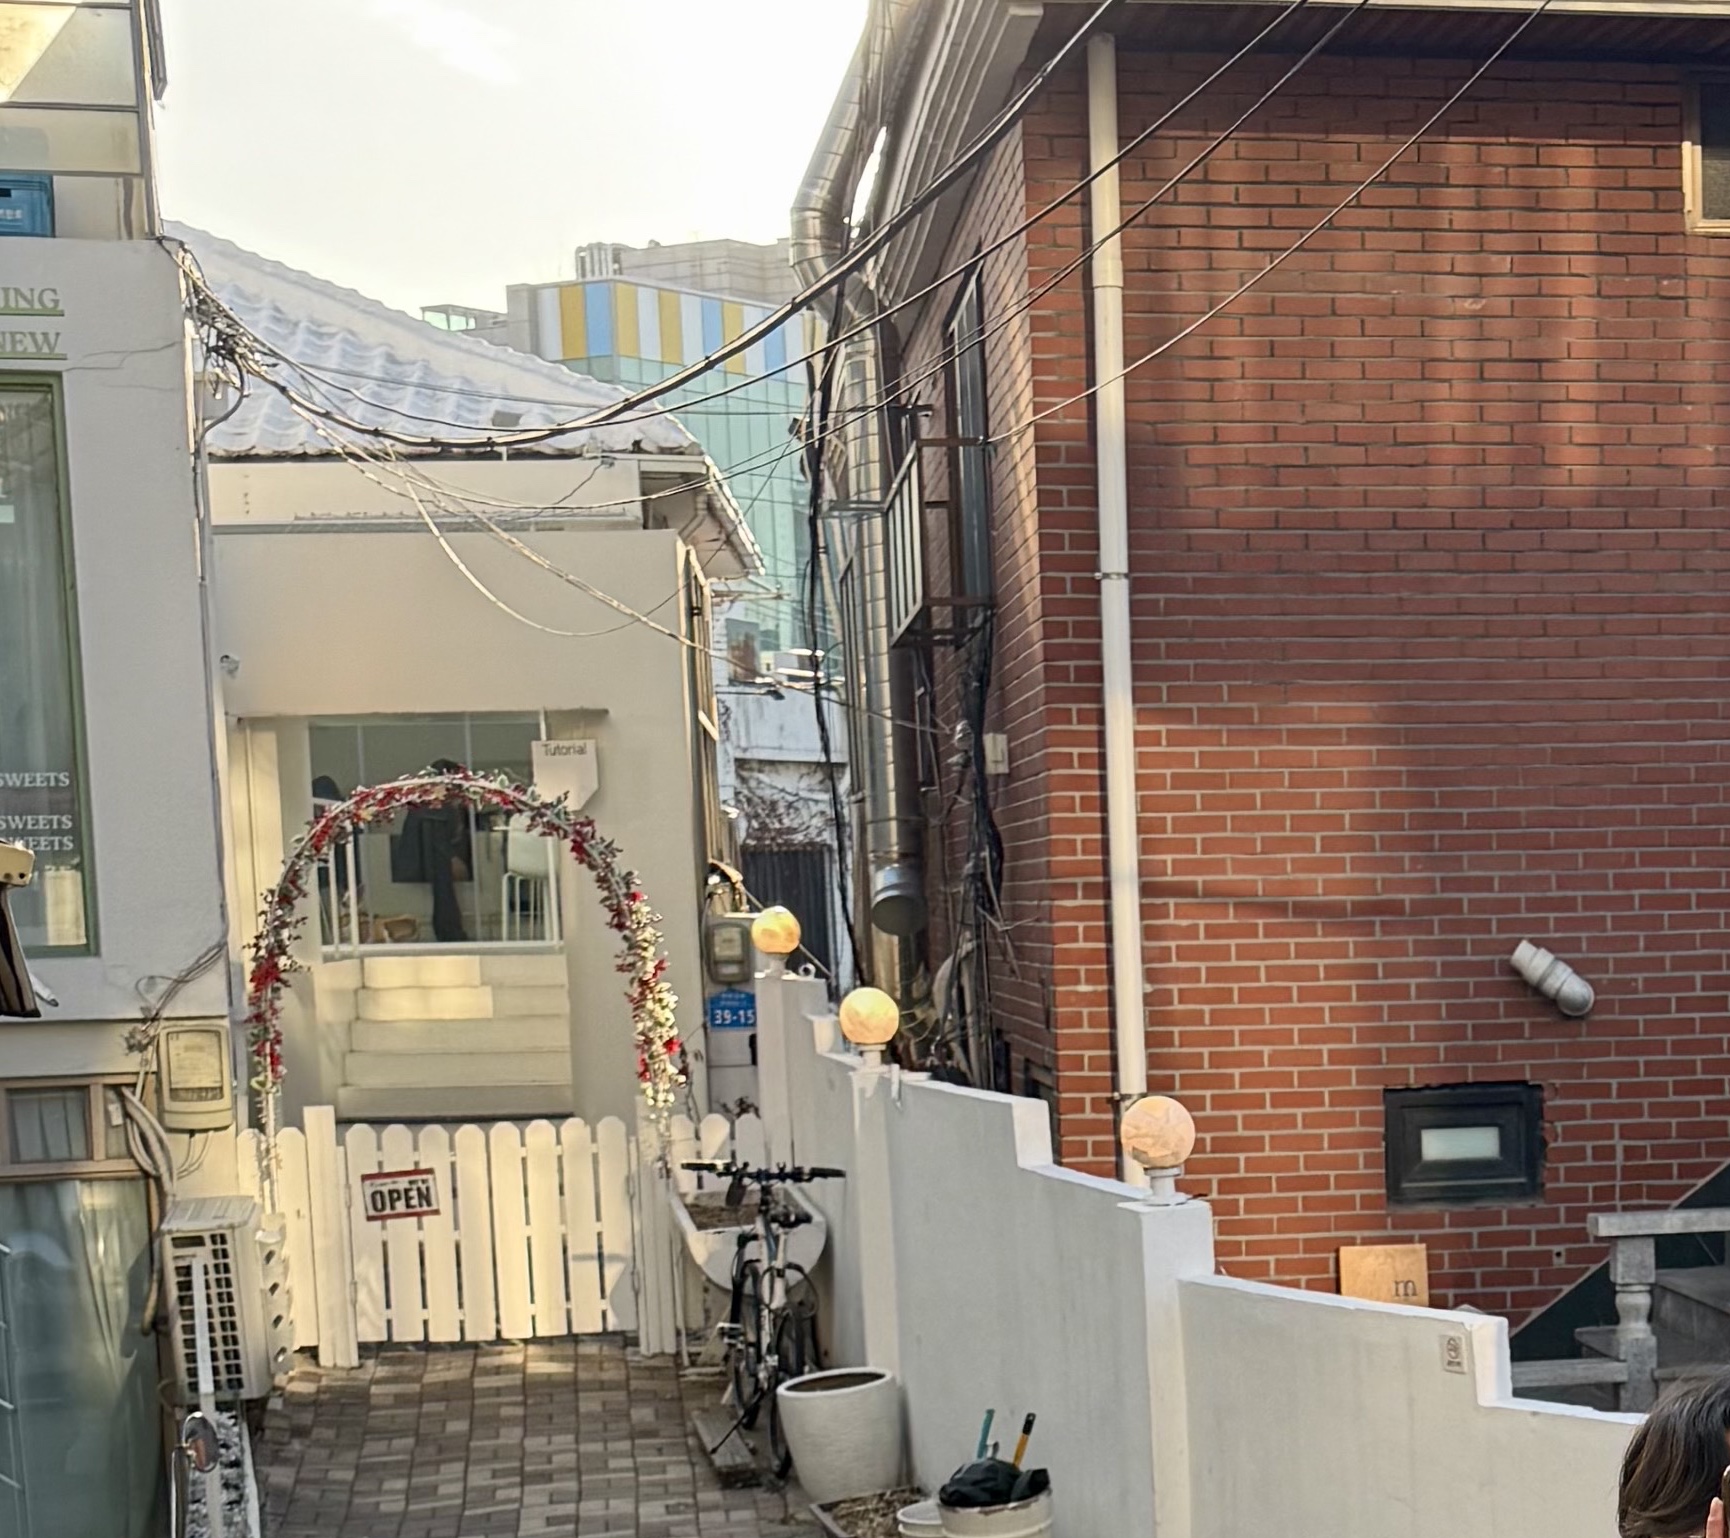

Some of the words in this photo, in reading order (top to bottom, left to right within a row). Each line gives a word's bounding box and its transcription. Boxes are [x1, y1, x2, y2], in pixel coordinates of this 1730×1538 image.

[542, 742, 587, 757] Tutorial
[714, 1009, 755, 1025] 39-15
[370, 1185, 433, 1213] OPEN
[1393, 1279, 1419, 1298] m
